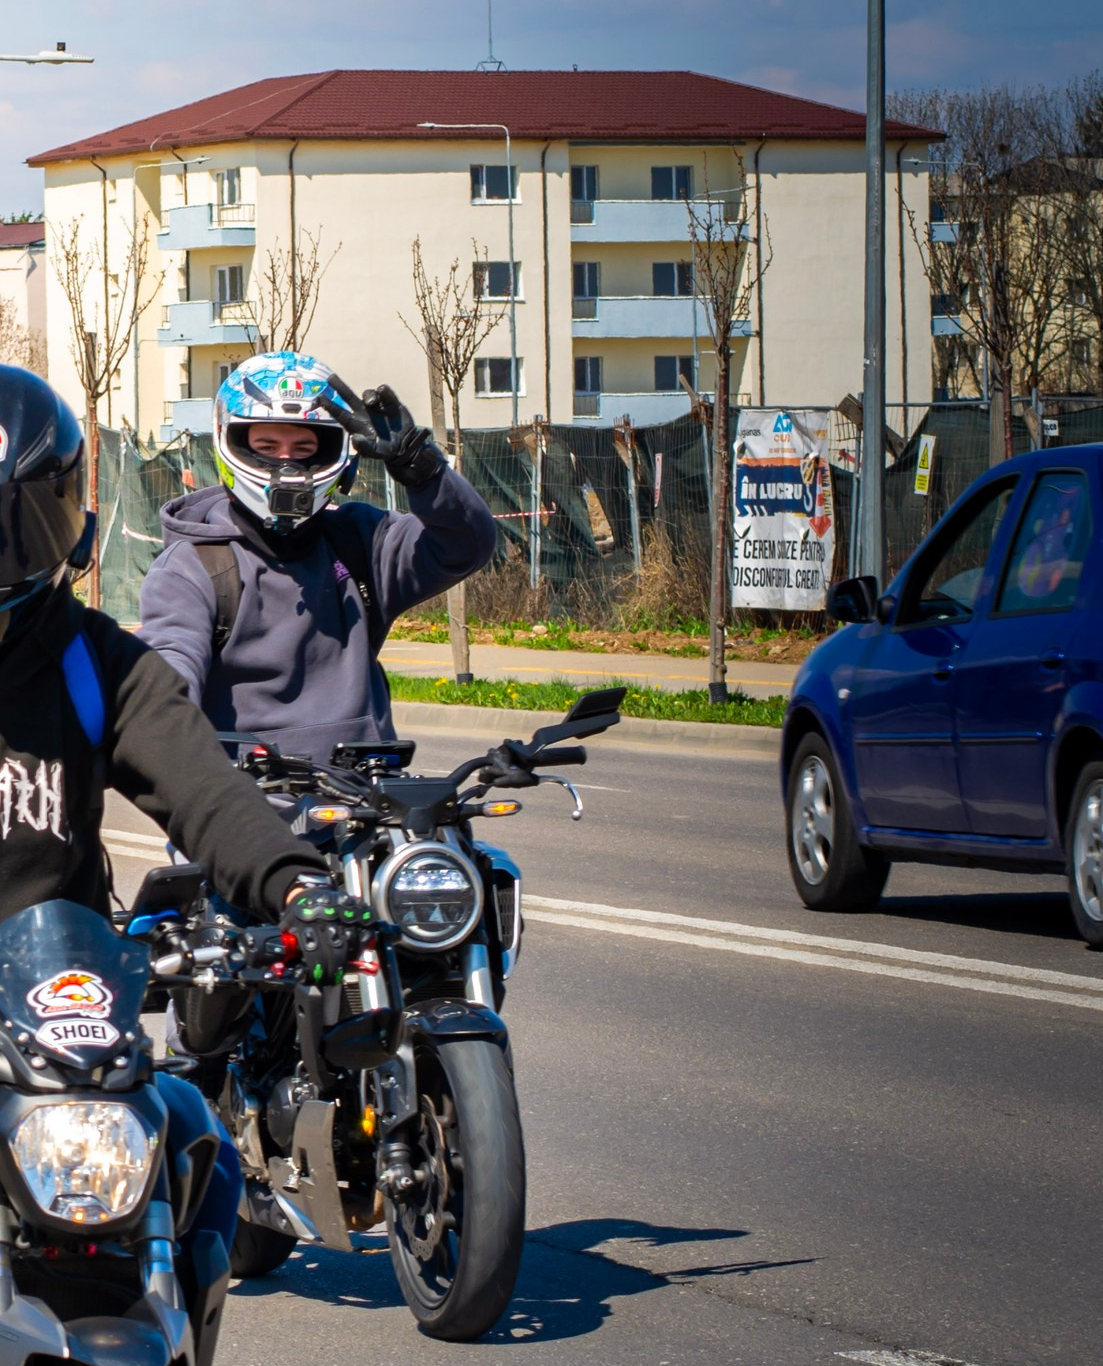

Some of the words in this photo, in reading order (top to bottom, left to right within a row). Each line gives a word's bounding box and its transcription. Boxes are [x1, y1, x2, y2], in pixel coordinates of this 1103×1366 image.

[740, 475, 757, 500] ÎN
[759, 482, 803, 500] LUCRU
[733, 539, 740, 559] E
[743, 539, 776, 560] CEREM
[799, 540, 826, 563] PENTRU
[50, 1024, 107, 1041] SHOEI
